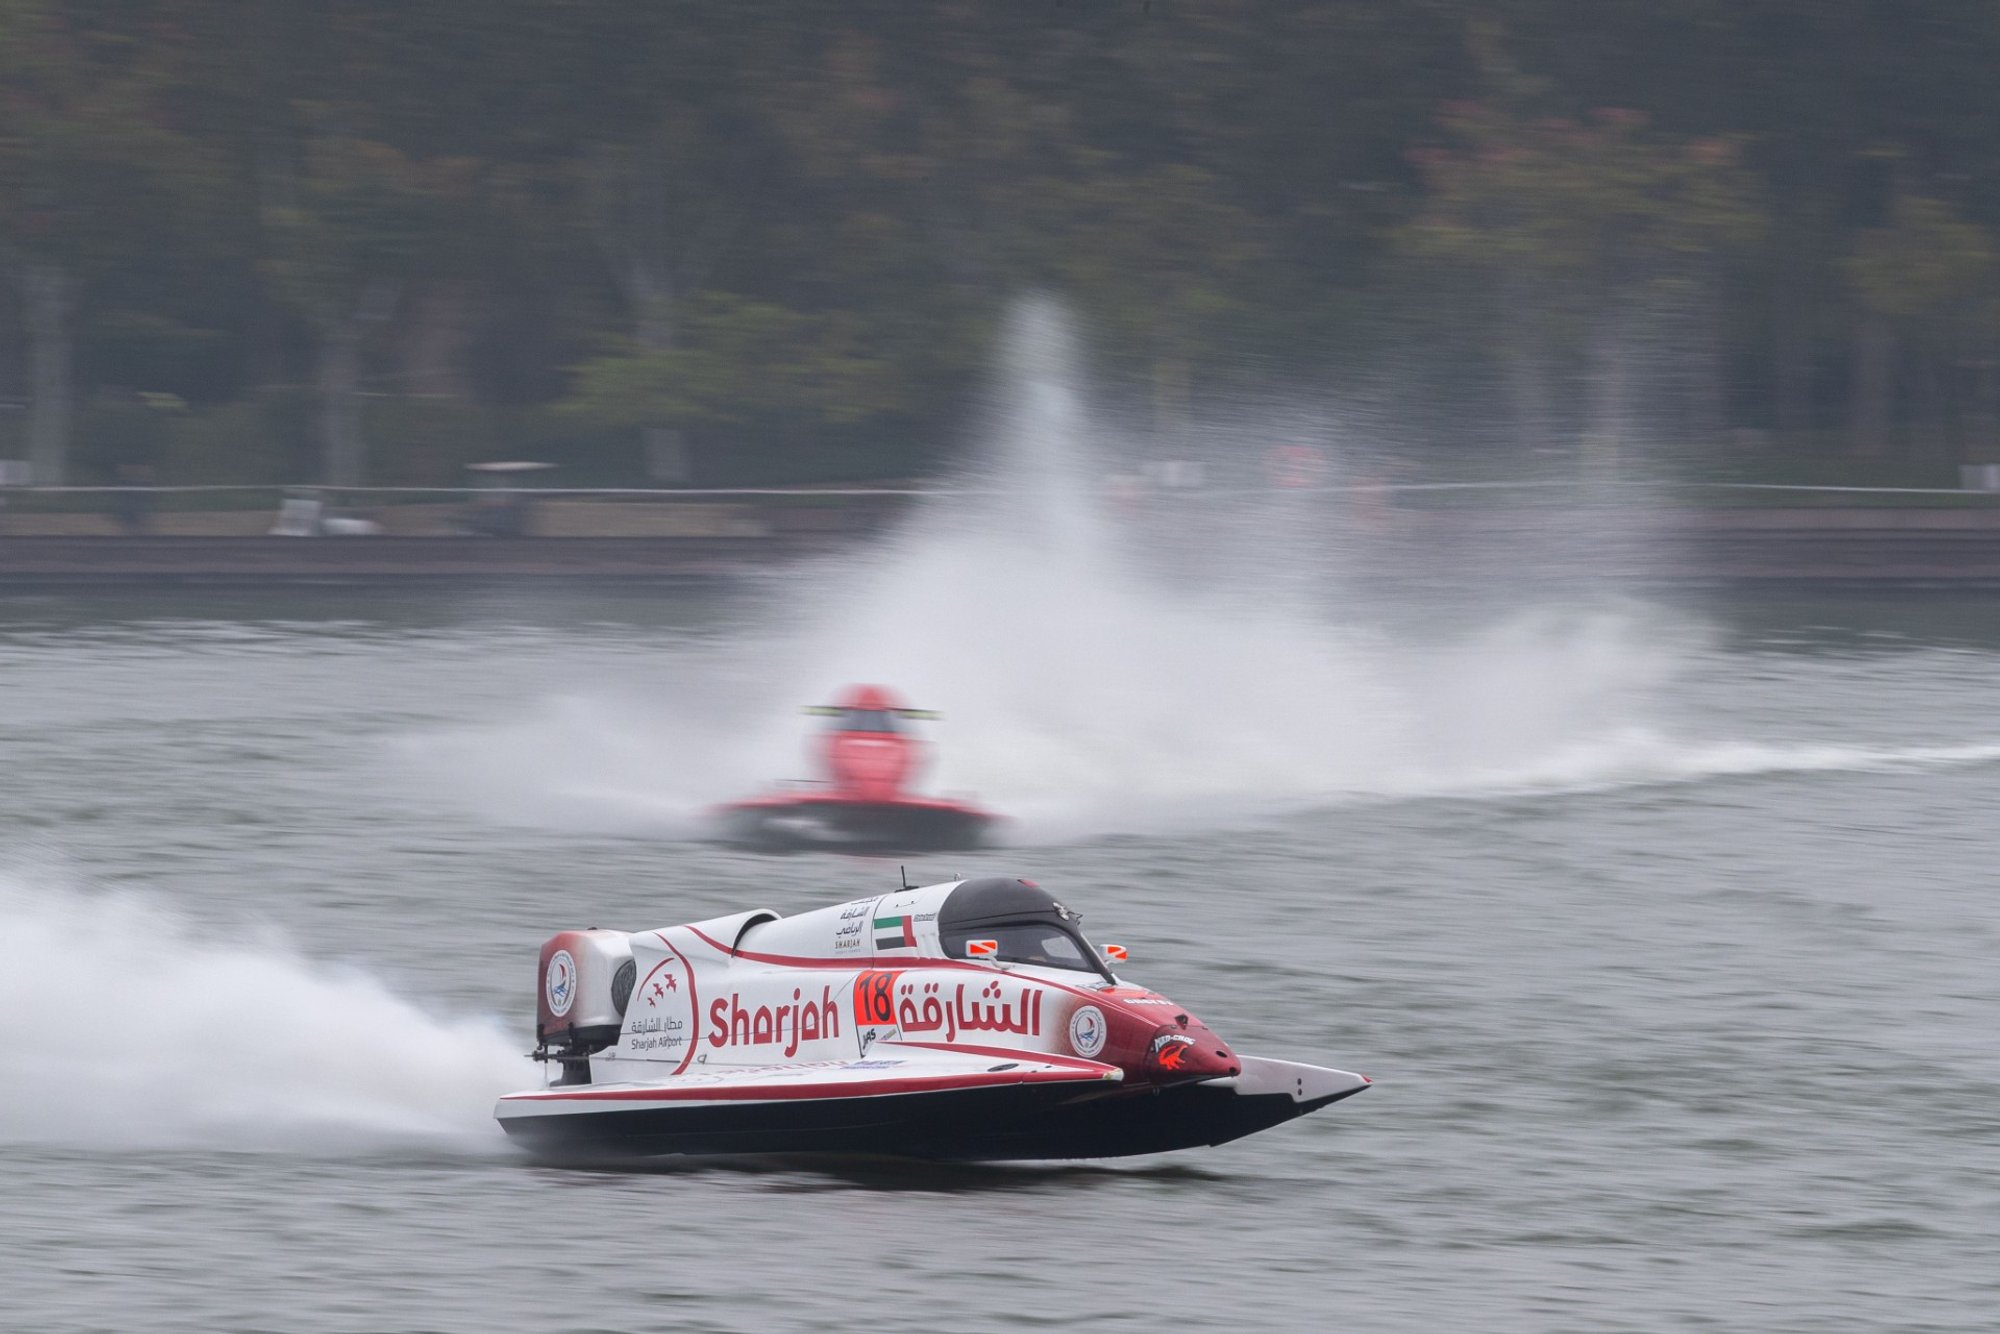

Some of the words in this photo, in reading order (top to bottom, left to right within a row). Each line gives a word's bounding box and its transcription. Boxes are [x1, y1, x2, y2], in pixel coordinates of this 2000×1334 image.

[859, 973, 892, 1022] 18
[899, 980, 1043, 1042] الشارقة
[631, 1017, 661, 1036] الشارقة
[664, 1016, 683, 1032] مطار
[708, 985, 839, 1058] Sharjah
[631, 1037, 657, 1051] Sharjah
[657, 1036, 682, 1049] Airport
